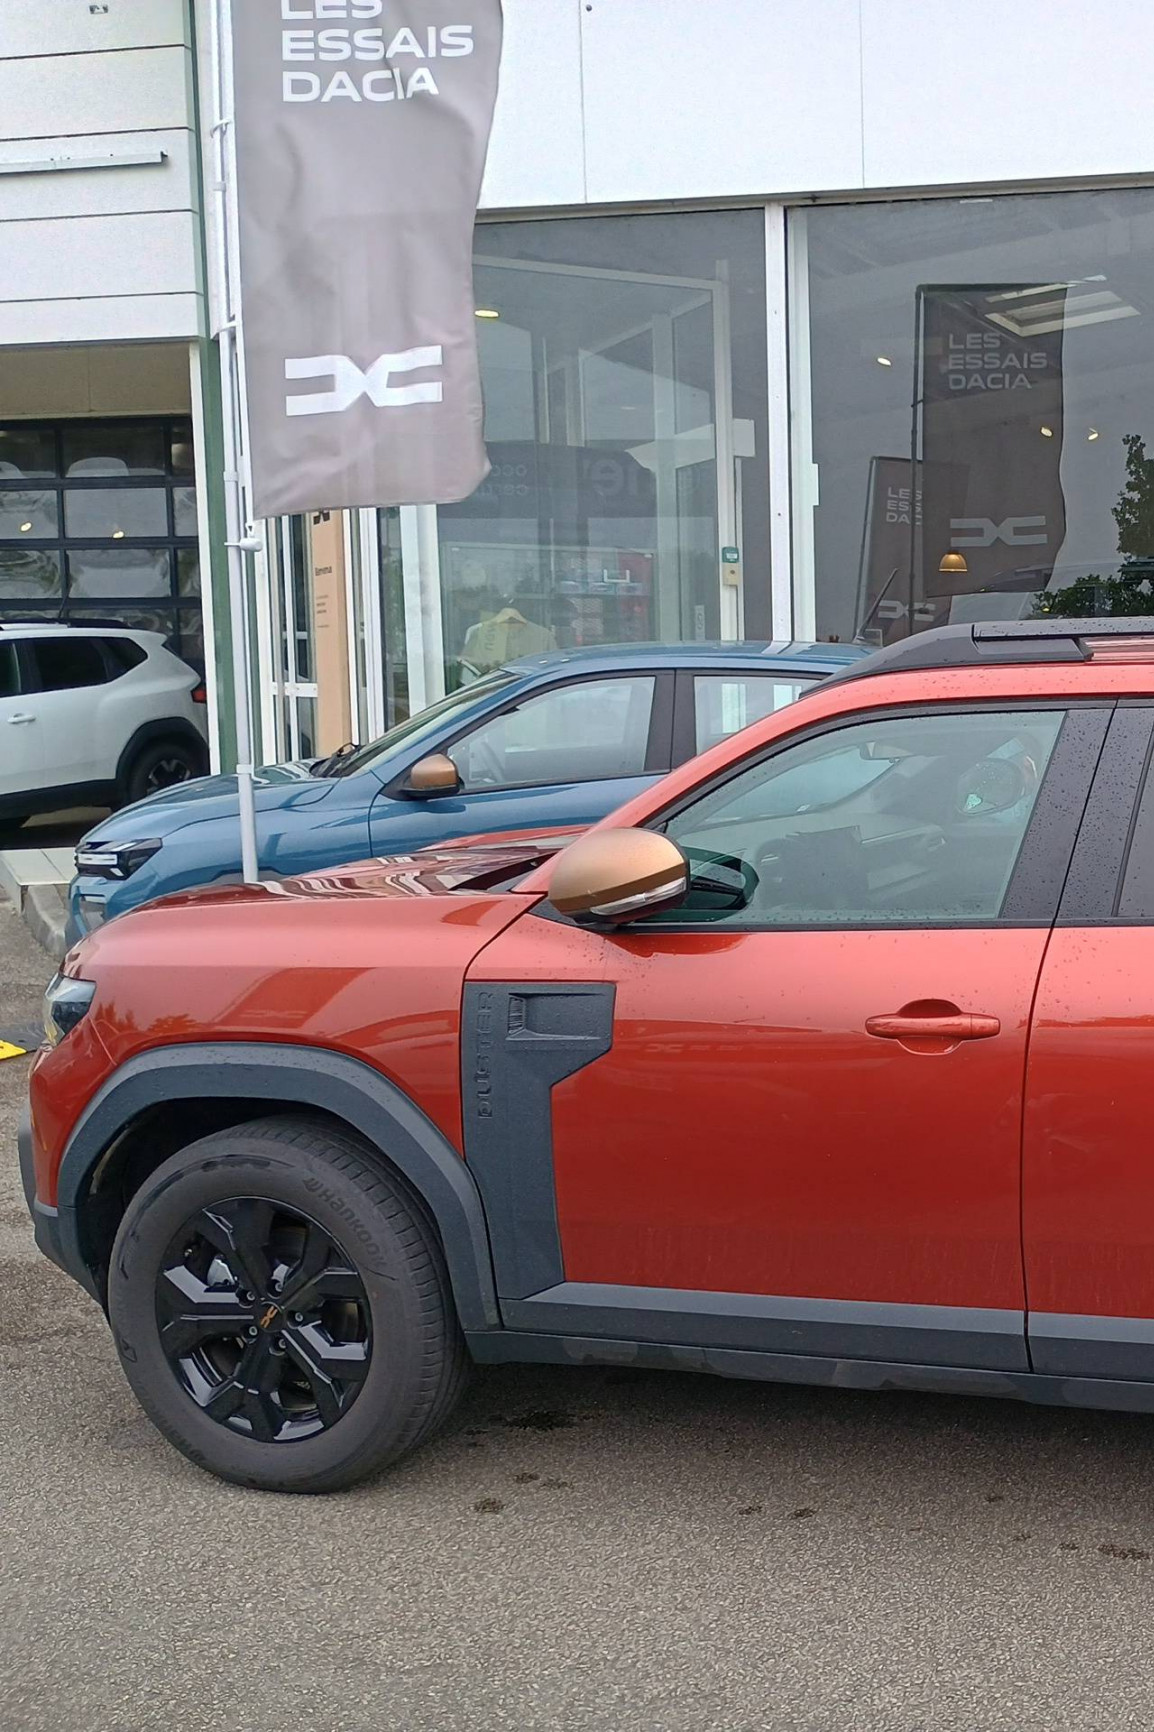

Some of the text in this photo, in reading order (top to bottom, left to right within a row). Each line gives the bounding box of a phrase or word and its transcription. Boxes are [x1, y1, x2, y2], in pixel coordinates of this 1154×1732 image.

[281, 0, 383, 19] LES
[282, 25, 474, 61] ESSAIS
[282, 67, 439, 102] DACIA
[949, 333, 1001, 349] LES
[948, 353, 1048, 370] ESSAIS
[948, 373, 1033, 390] DACIA
